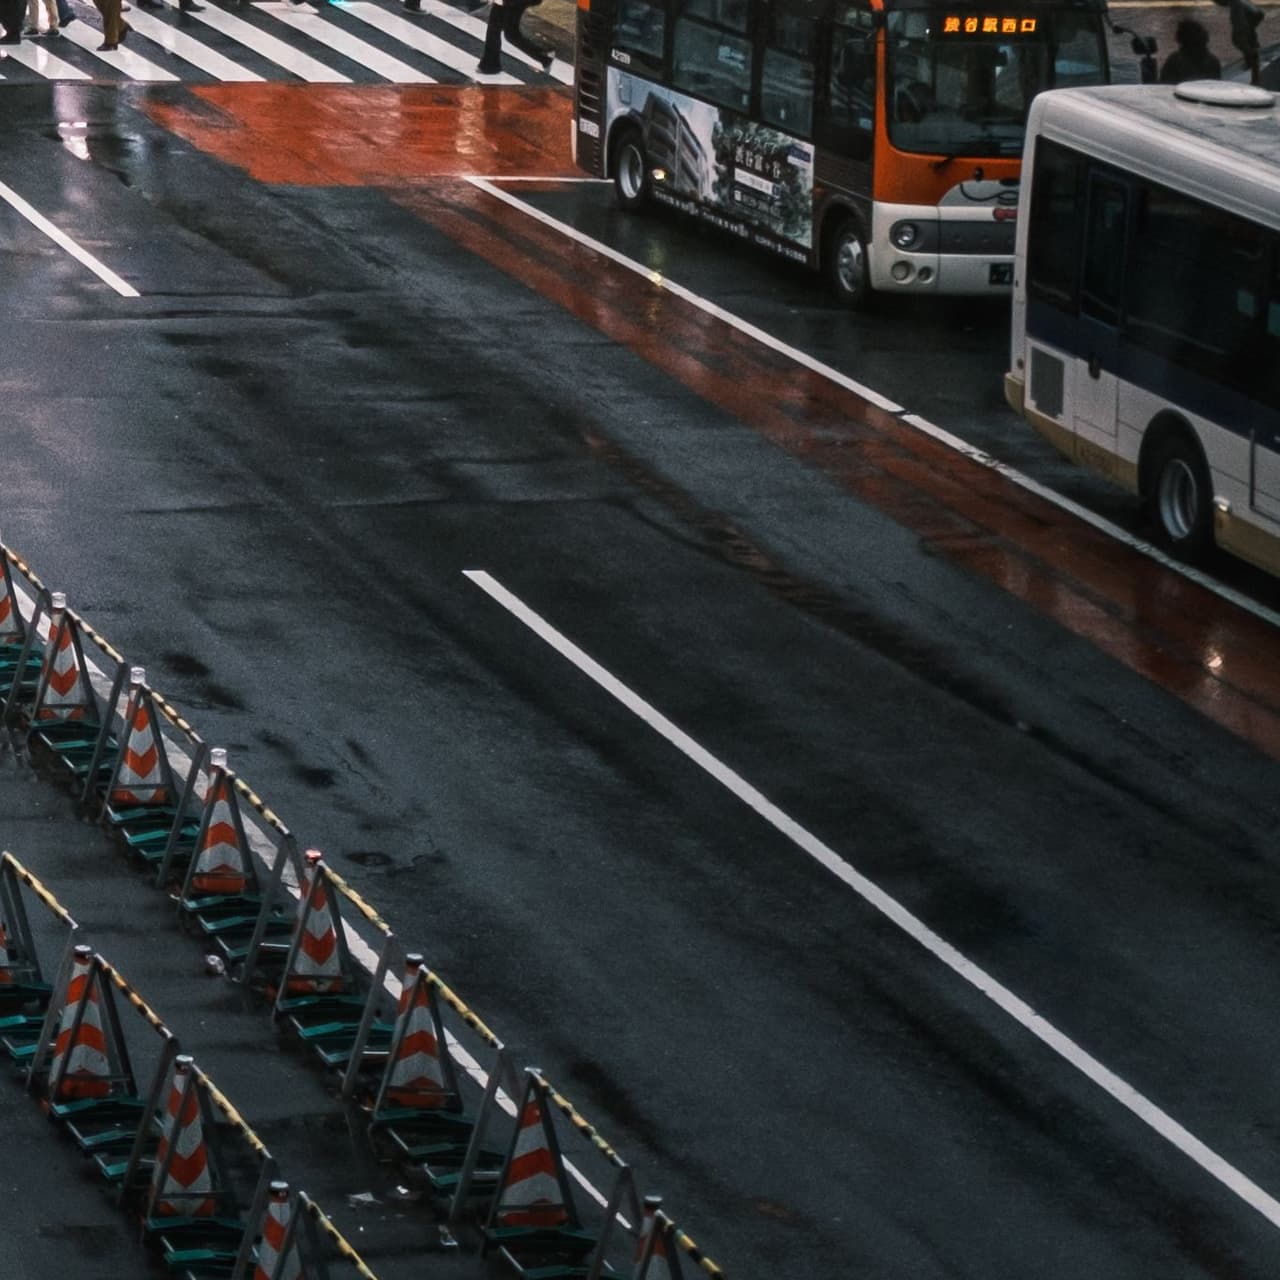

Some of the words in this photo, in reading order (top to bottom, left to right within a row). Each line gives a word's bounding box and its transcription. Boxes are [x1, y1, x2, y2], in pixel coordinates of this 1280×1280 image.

[944, 16, 1037, 33] 渋谷駅西口
